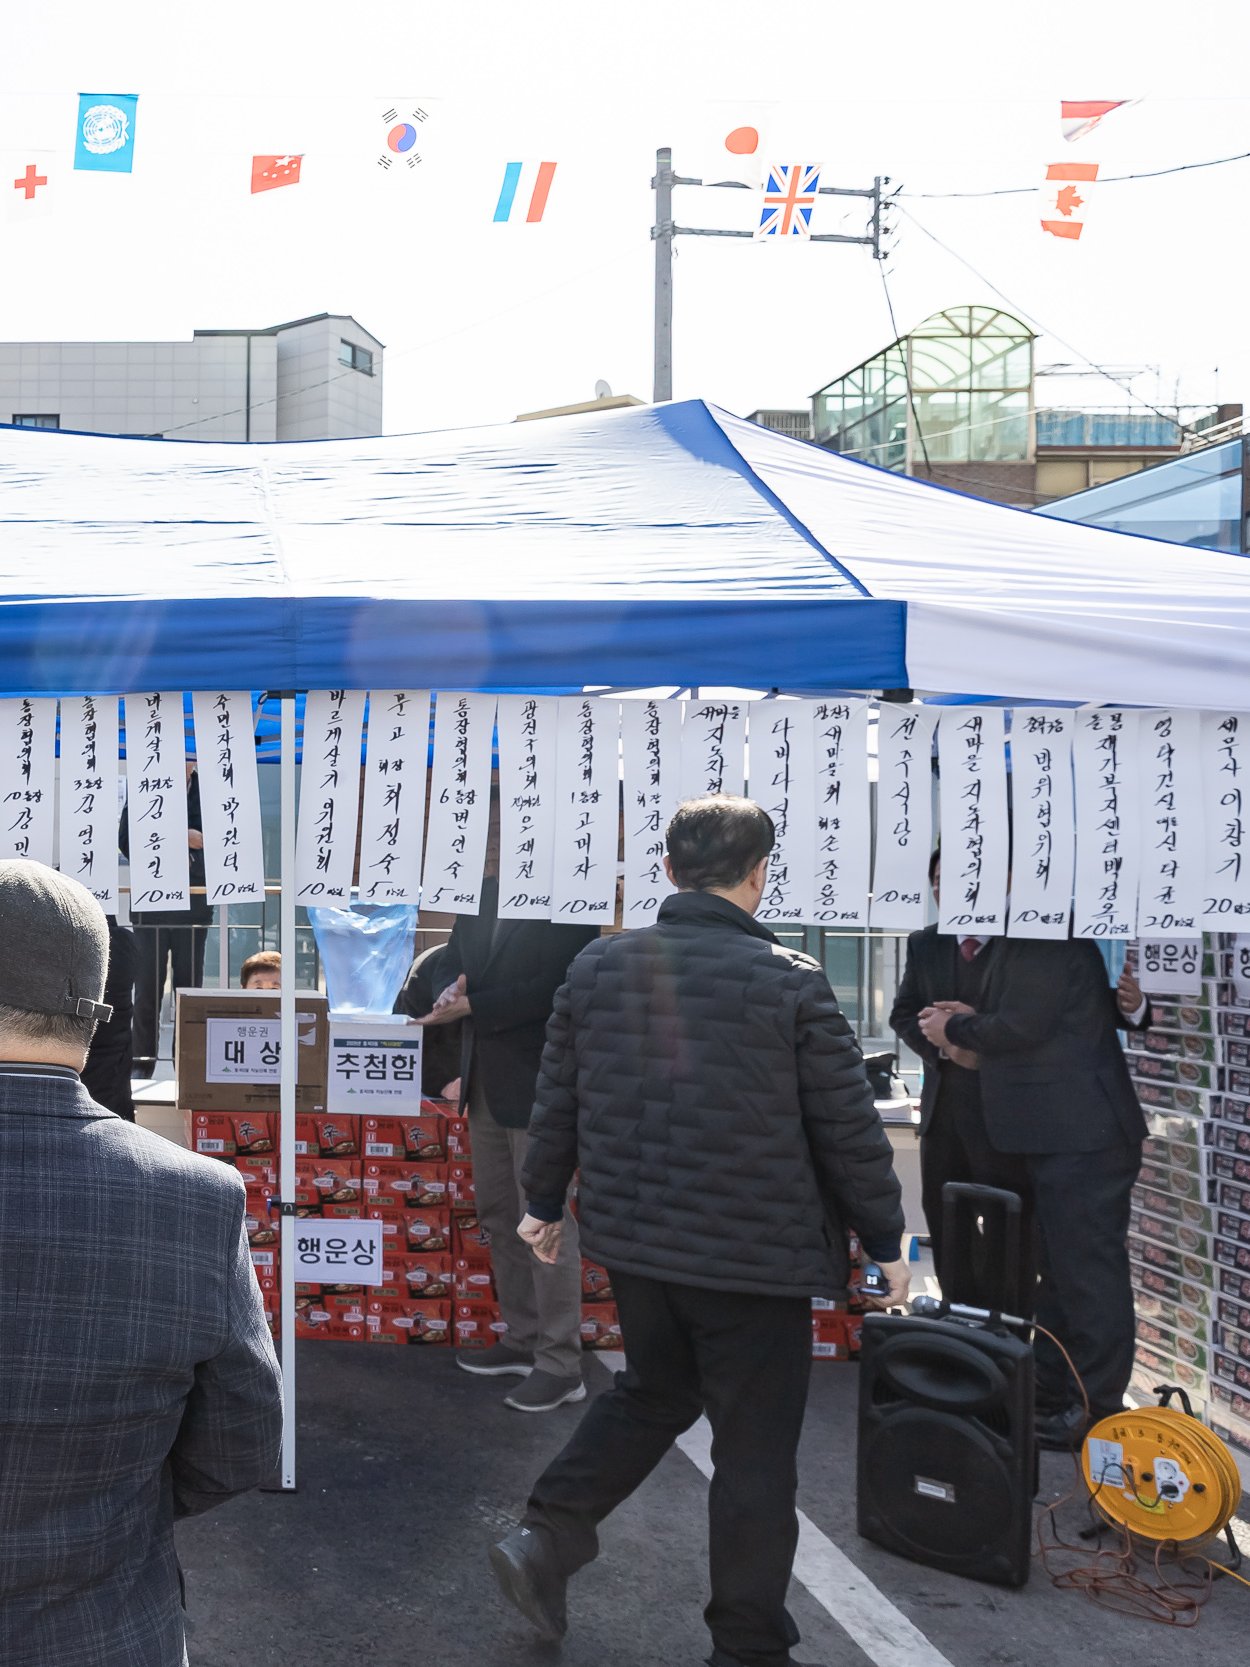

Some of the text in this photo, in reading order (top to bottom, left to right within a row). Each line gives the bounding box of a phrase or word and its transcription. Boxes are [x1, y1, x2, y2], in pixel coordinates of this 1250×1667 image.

[1145, 944, 1198, 974] 행운상
[237, 1026, 269, 1038] 행운권
[336, 1053, 417, 1081] 추첨함
[297, 1237, 376, 1265] 행운상
